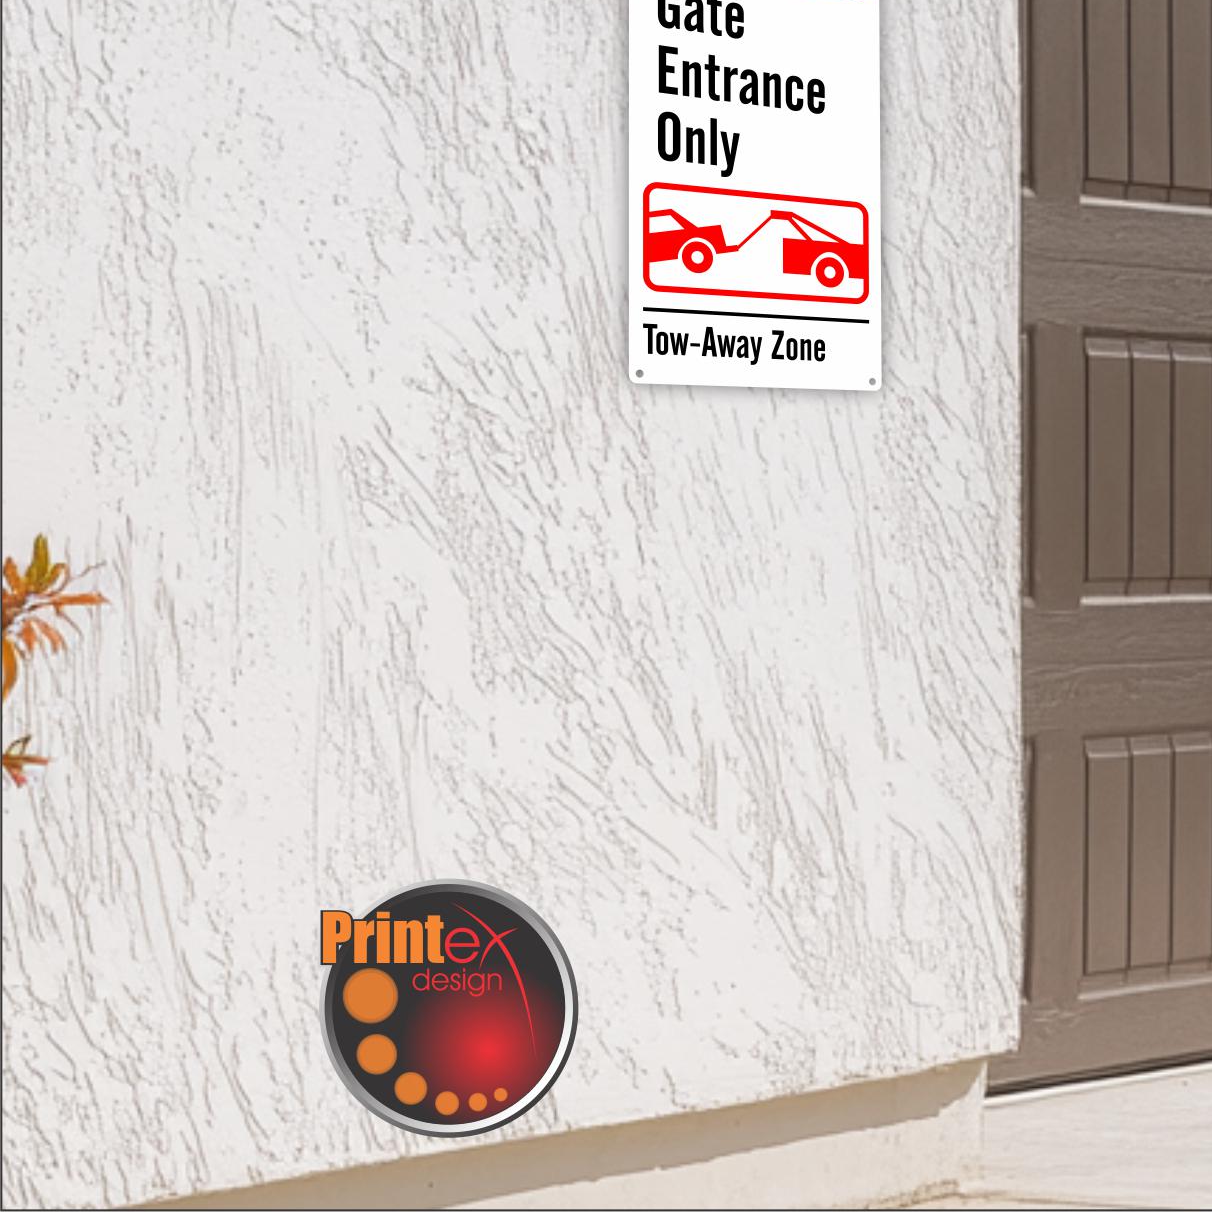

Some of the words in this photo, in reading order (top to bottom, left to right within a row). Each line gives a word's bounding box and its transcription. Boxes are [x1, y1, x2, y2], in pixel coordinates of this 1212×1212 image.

[658, 44, 826, 114] Entrance
[657, 111, 740, 178] Only
[643, 323, 763, 365] Tow-Away
[771, 329, 826, 362] Zone
